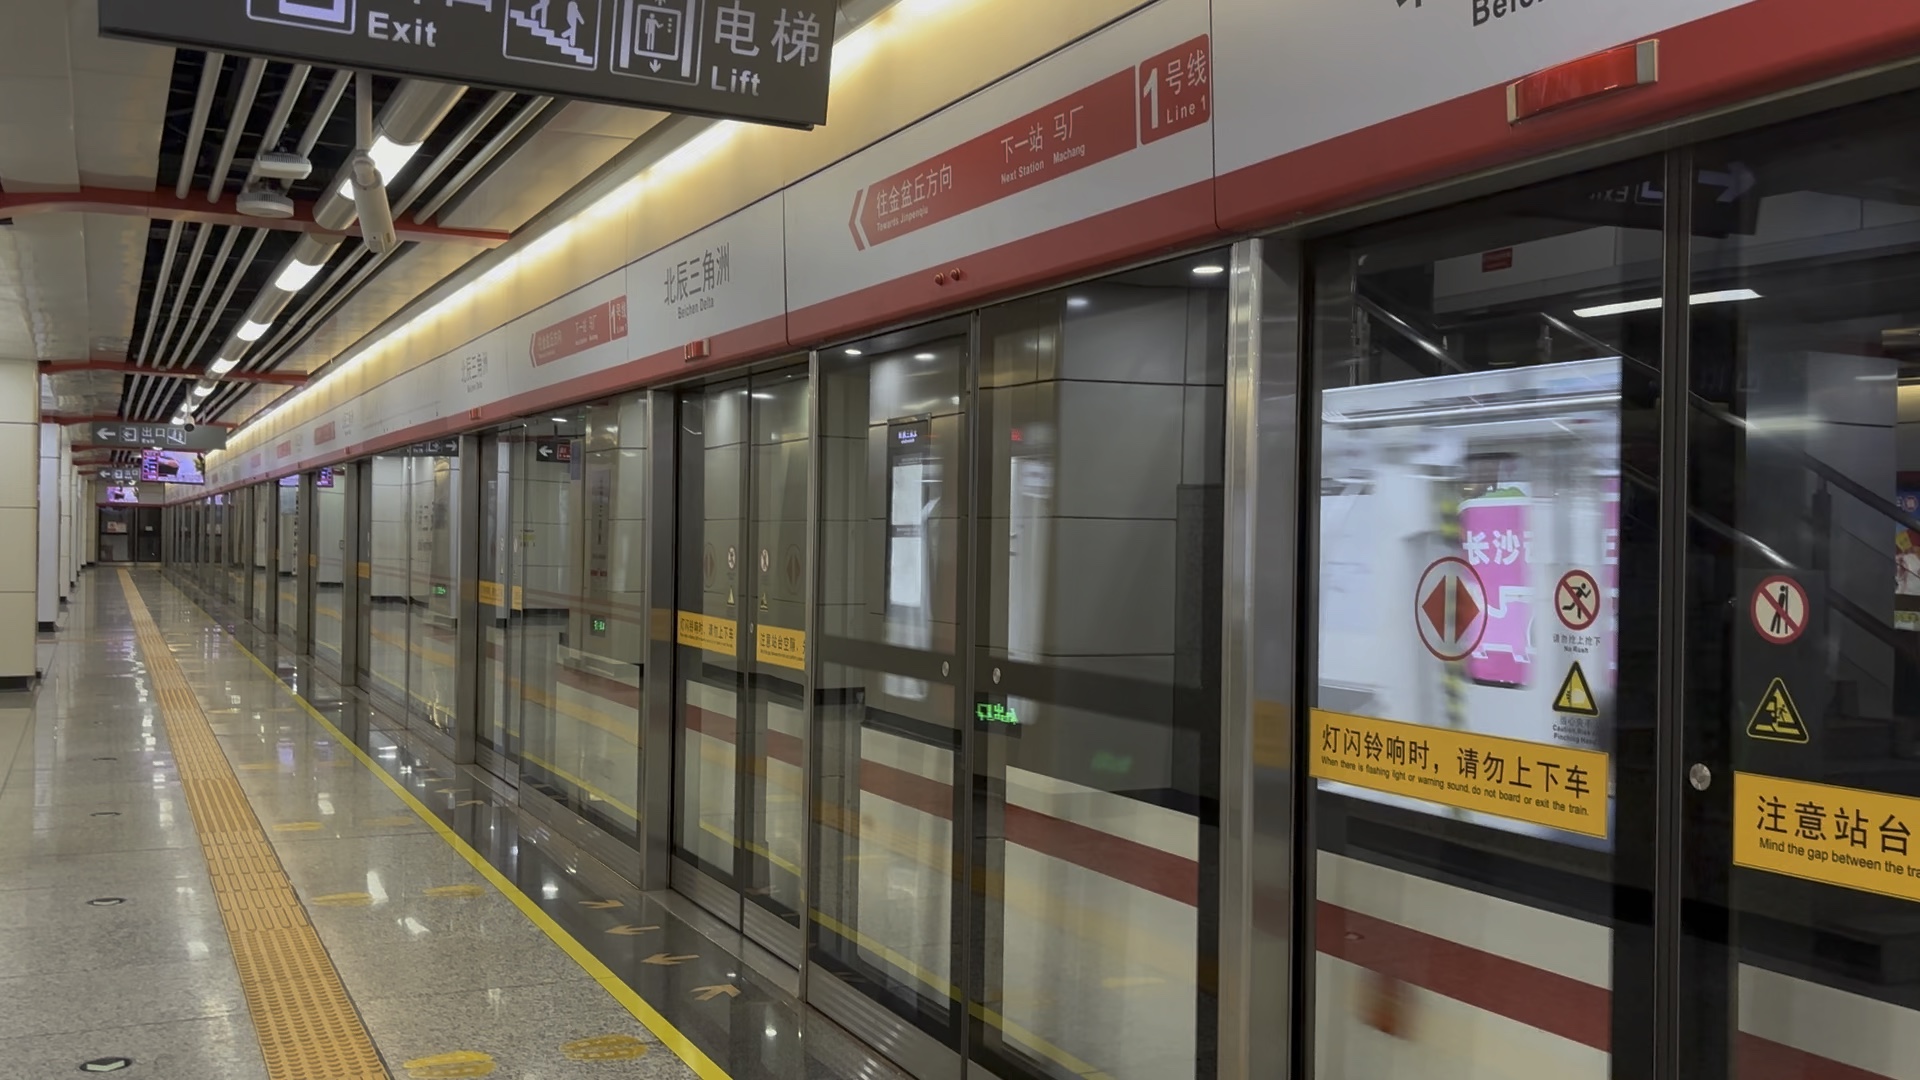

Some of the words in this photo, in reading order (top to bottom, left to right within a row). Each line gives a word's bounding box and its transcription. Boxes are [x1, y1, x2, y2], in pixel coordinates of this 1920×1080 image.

[368, 10, 437, 47] Exit
[714, 0, 820, 67] 电梯
[711, 65, 760, 97] Lift
[1166, 103, 1195, 124] Line
[1200, 94, 1206, 111] 1
[1001, 121, 1043, 164] 下一站
[1053, 105, 1084, 141] 马厂
[1001, 169, 1017, 185] Next
[1018, 160, 1045, 178] Station
[1053, 144, 1086, 165] Machang
[876, 163, 952, 219] 往金盆丘方向
[876, 217, 899, 232] Towards
[664, 241, 730, 306] 北辰三角洲
[142, 426, 166, 438] 出口
[1322, 724, 1590, 799] 灯闪铃响时，请勿上下车
[1321, 755, 1339, 767] When
[1340, 758, 1356, 771] there
[1358, 760, 1364, 772] is
[1365, 763, 1390, 780] flashing
[1392, 769, 1406, 781] light
[1407, 773, 1416, 782] or
[1418, 776, 1445, 790] warning
[1471, 784, 1482, 796] do
[1484, 787, 1496, 798] not
[1499, 790, 1521, 803] board
[1523, 796, 1533, 805] or
[1535, 798, 1550, 809] exit
[1552, 801, 1566, 812] the
[1568, 803, 1590, 817] train.
[1756, 795, 1911, 857] 注意站台
[1759, 837, 1785, 853] Mind
[1787, 842, 1805, 857] the
[1807, 848, 1829, 863] gap
[1831, 850, 1882, 871] between
[1884, 860, 1904, 876] the
